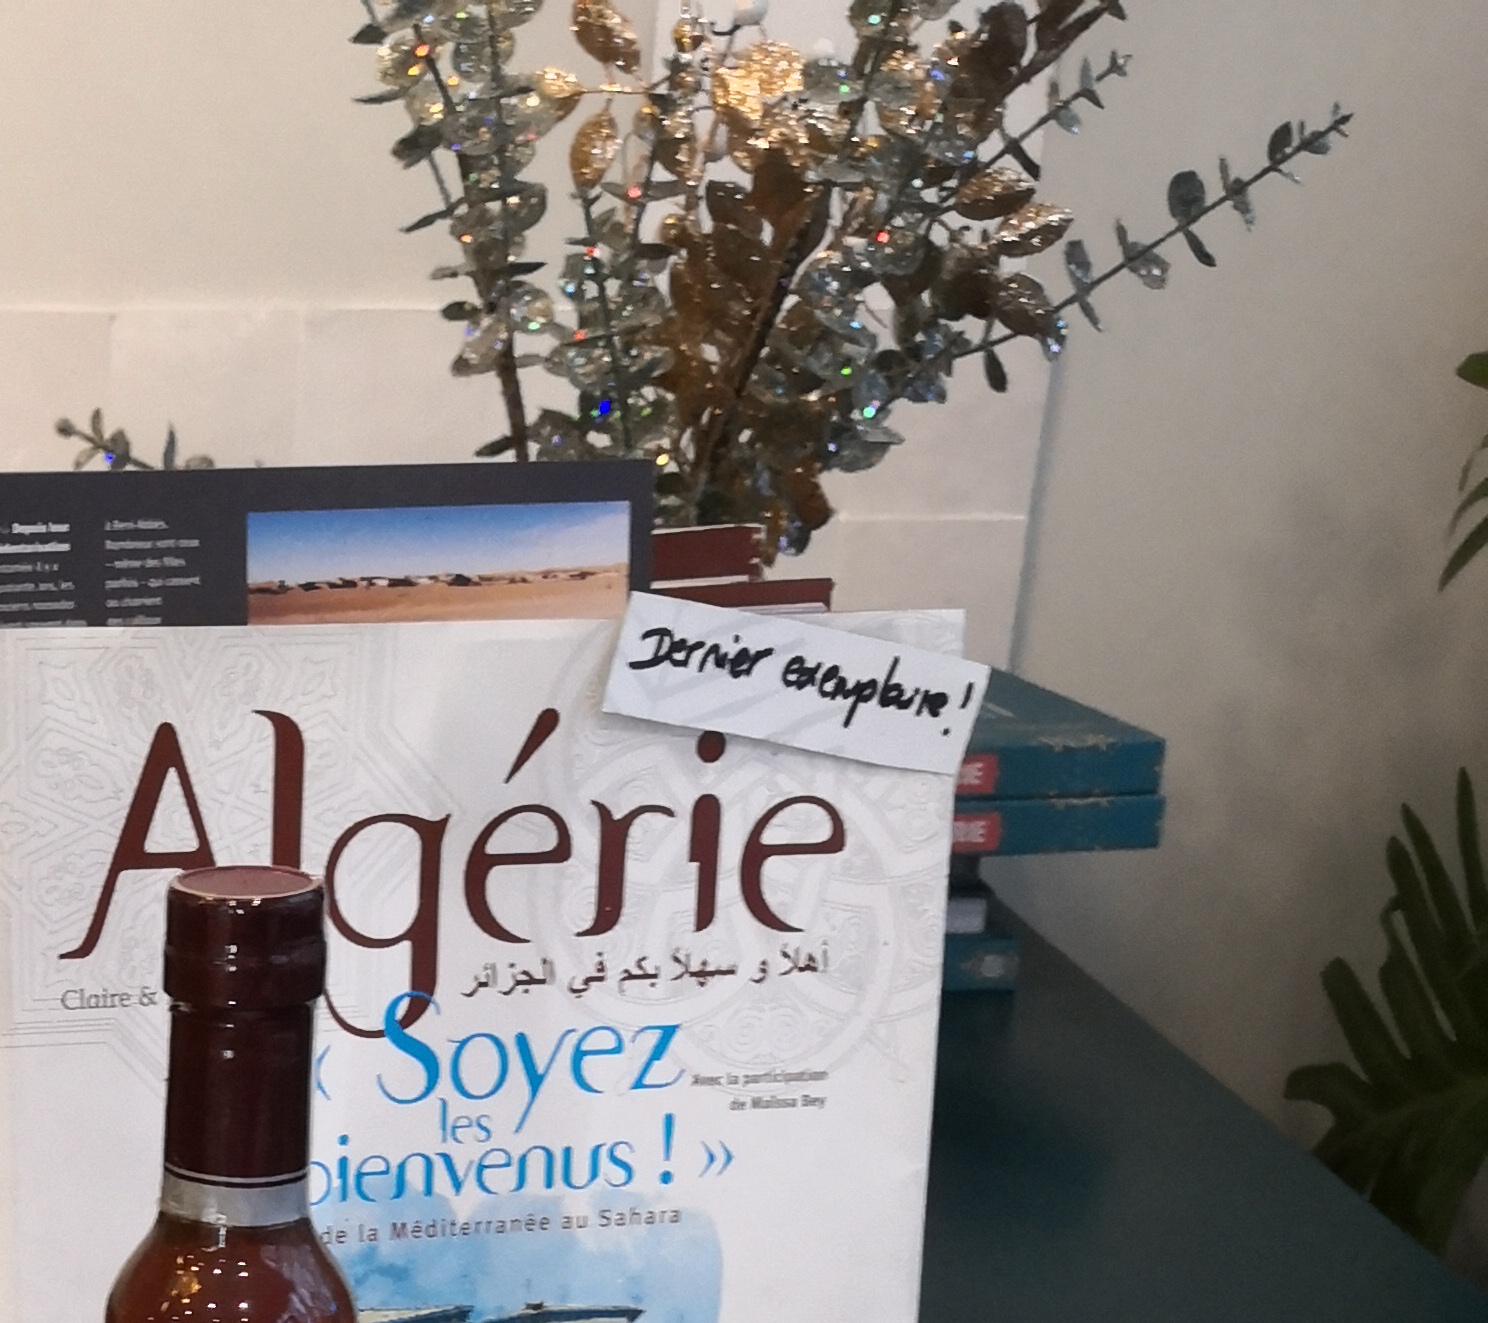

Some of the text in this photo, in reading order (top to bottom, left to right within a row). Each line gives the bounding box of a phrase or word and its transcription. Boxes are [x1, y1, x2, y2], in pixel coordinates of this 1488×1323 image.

[627, 627, 774, 679] Dernier
[59, 708, 847, 1039] Algérie
[461, 956, 555, 997] الجزائر
[568, 951, 607, 998] في
[618, 956, 661, 995] بكم
[61, 987, 131, 1010] Claire
[375, 991, 685, 1134] Soyez
[437, 1097, 492, 1144] les
[320, 1207, 683, 1246] de la Méditerranée au Sahara
